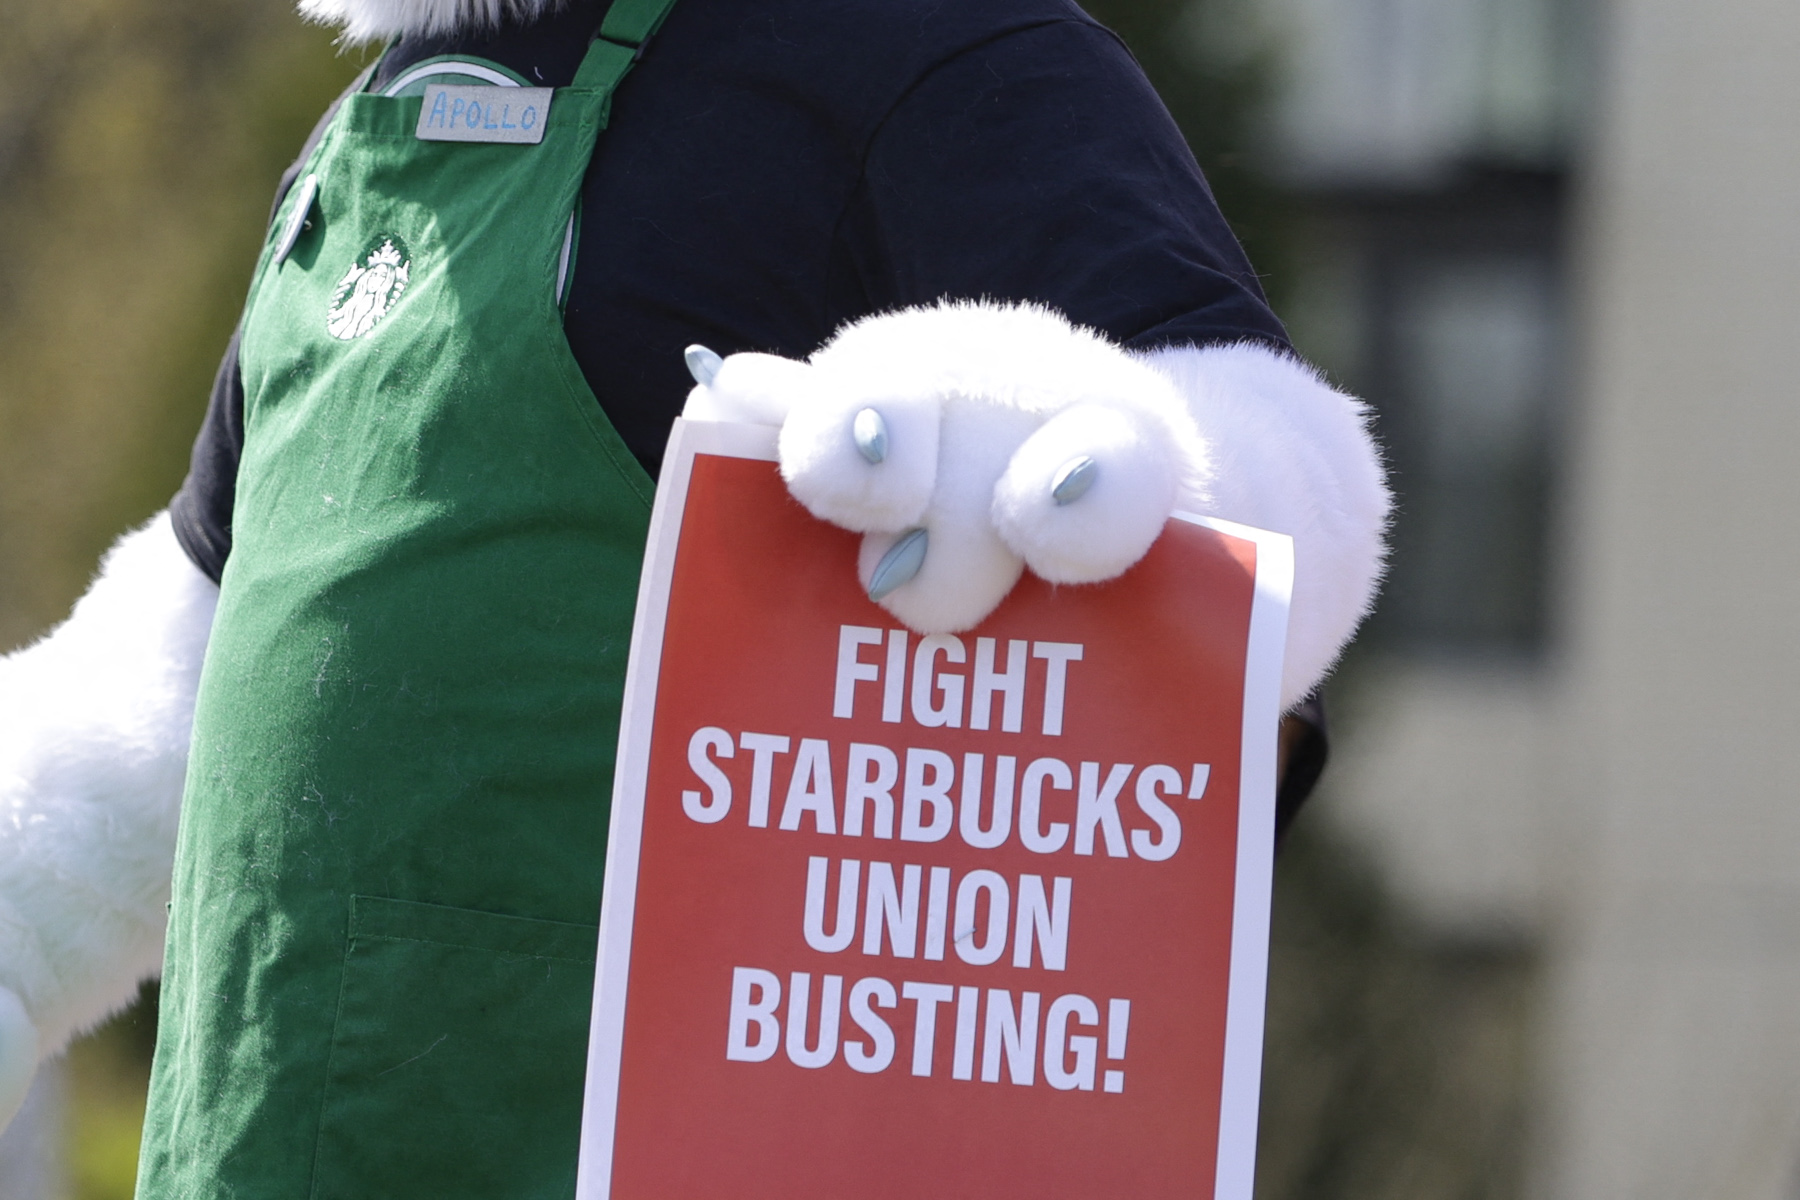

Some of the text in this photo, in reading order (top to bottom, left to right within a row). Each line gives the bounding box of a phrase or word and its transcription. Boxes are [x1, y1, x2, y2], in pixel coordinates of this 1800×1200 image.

[427, 91, 537, 130] APOLLO
[833, 624, 1084, 736] FIGHT
[681, 726, 1210, 862] STARBUCKS'
[803, 855, 1072, 971] UNION
[726, 966, 1131, 1094] BUSTING!
